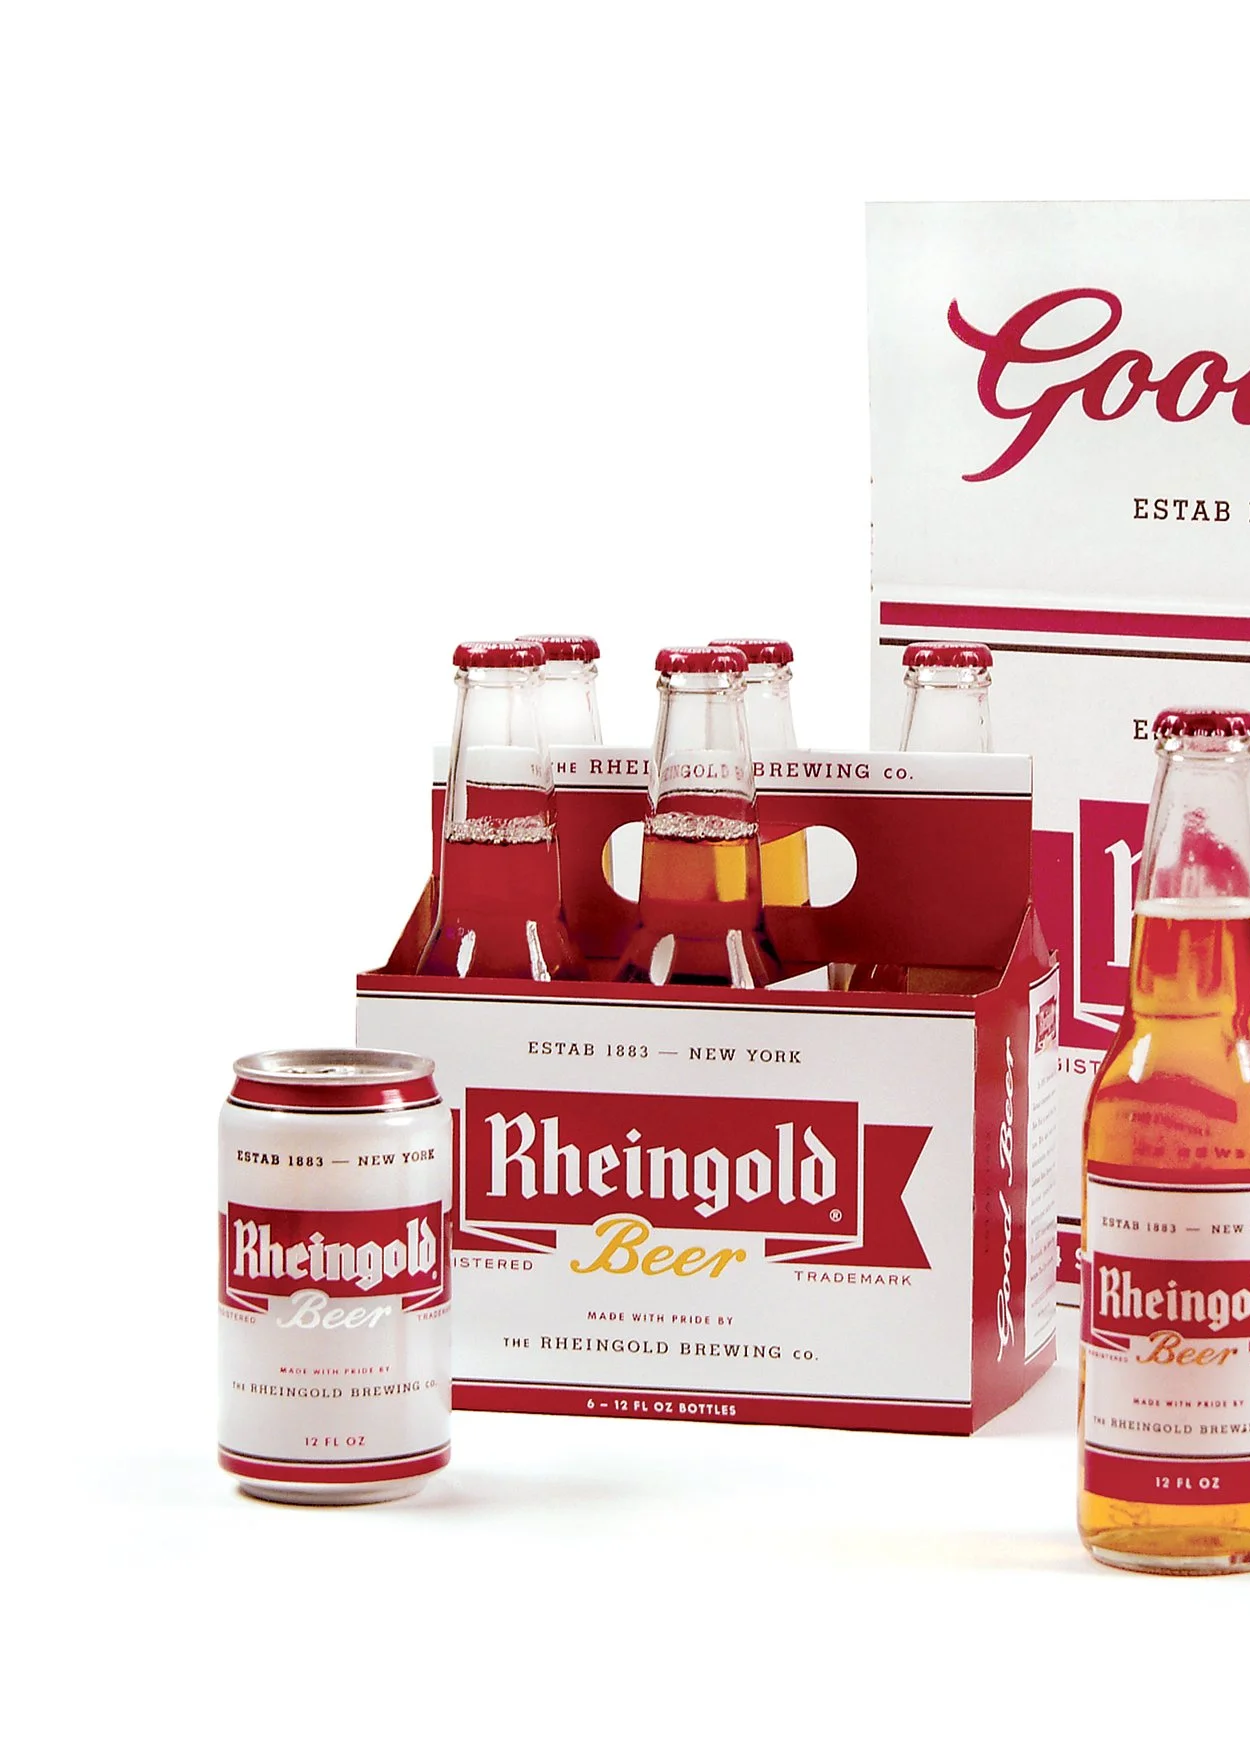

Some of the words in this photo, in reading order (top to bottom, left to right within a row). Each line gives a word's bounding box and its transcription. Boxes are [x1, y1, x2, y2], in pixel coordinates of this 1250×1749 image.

[1133, 497, 1231, 522] ESTAB
[552, 760, 578, 778] HE
[752, 762, 870, 782] BREWING
[528, 1041, 595, 1056] ESTAB
[607, 1044, 649, 1059] 1883
[689, 1047, 736, 1061] NEW
[746, 1049, 801, 1064] YORK
[999, 1035, 1015, 1187] Beer
[237, 1149, 280, 1166] ESTAB
[288, 1155, 324, 1167] 1883
[357, 1154, 395, 1167] NEW
[401, 1148, 435, 1164] YORK
[485, 1111, 837, 1218] Rheingold
[1102, 1216, 1140, 1231] ESTAB
[1147, 1222, 1177, 1234] 1883
[1211, 1224, 1244, 1235] NEW
[233, 1217, 436, 1292] Rheingold
[570, 1218, 746, 1279] Beer
[453, 1256, 533, 1271] ISTERED
[794, 1270, 913, 1287] TRADEMARK
[997, 1190, 1014, 1362] Good
[277, 1289, 392, 1329] Beer
[587, 1311, 624, 1321] MADE
[631, 1313, 665, 1323] WITH
[671, 1314, 710, 1325] PRIDE
[717, 1316, 733, 1326] BY
[503, 1337, 529, 1348] THE
[541, 1336, 669, 1355] RHEINGOLD
[680, 1342, 781, 1359] BREWING
[1136, 1331, 1238, 1368] Beer
[279, 1366, 307, 1375] MADE
[313, 1368, 339, 1376] WITH
[344, 1367, 373, 1375] PRIDE
[232, 1380, 245, 1391] THE
[250, 1383, 343, 1399] RHEINGOLD
[350, 1382, 420, 1398] BREWING
[586, 1398, 595, 1409] 6
[614, 1399, 628, 1411] 12
[633, 1400, 649, 1412] FL
[653, 1401, 673, 1413] OZ
[679, 1403, 737, 1417] BOTTLES
[1133, 1398, 1160, 1407] MADE
[1165, 1400, 1192, 1408] WITH
[1196, 1400, 1227, 1408] PRIDE
[1232, 1399, 1244, 1408] BY
[1092, 1415, 1105, 1425] THE
[1111, 1418, 1192, 1434] RHEINGOLD
[305, 1437, 318, 1447] 12
[324, 1437, 339, 1447] FL
[345, 1435, 365, 1447] OZ
[1155, 1476, 1170, 1489] 12
[1176, 1477, 1192, 1490] FL
[1198, 1476, 1220, 1490] OZ
